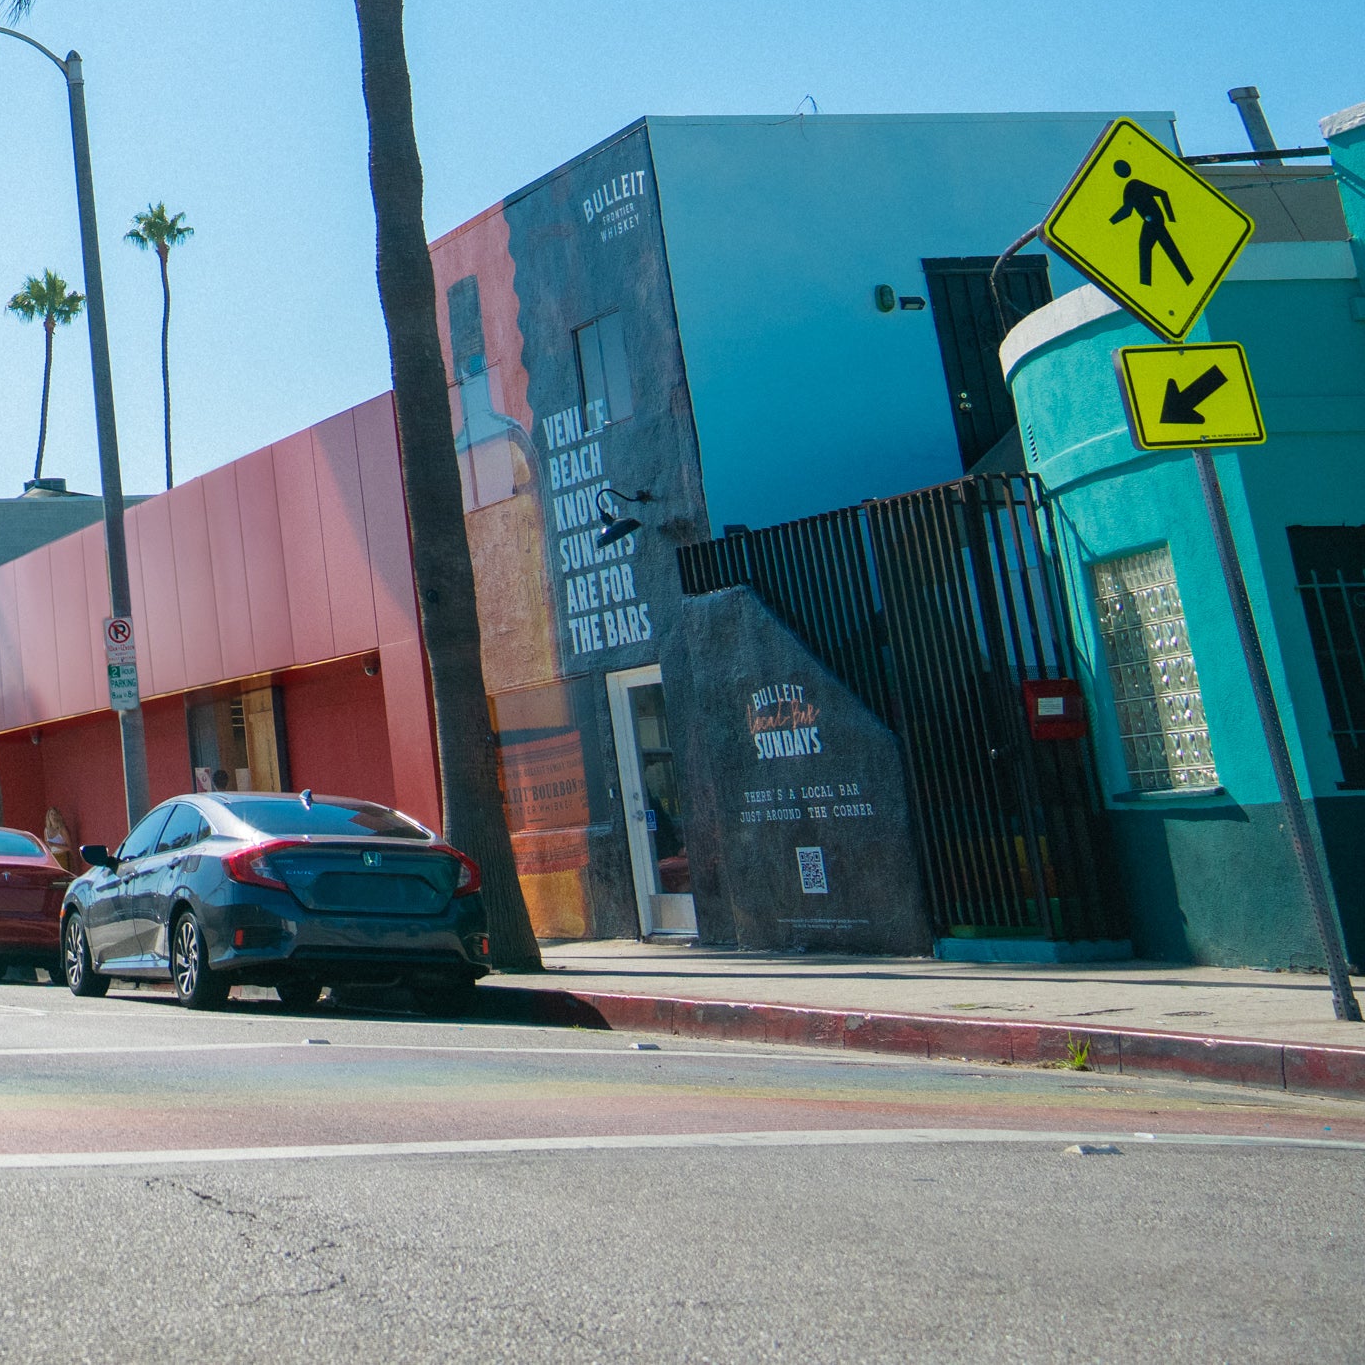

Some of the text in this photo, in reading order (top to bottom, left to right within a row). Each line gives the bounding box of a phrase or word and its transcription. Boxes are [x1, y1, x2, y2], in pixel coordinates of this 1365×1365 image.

[582, 170, 645, 224] BULLEIT
[600, 213, 640, 243] WHISKEY
[602, 202, 635, 226] FRONTIER
[549, 441, 603, 491] BEACH
[565, 572, 599, 614] ARE
[599, 563, 637, 606] FOR
[568, 602, 652, 655] THE BARS
[110, 678, 137, 689] PARKING
[751, 683, 804, 712] BULLEIT
[754, 726, 822, 760] SUNDAYS
[532, 778, 578, 802] BOURBON
[743, 783, 860, 803] THERE'S A LOCAL BAR
[739, 803, 874, 823] JUST AROUND THE CORNER
